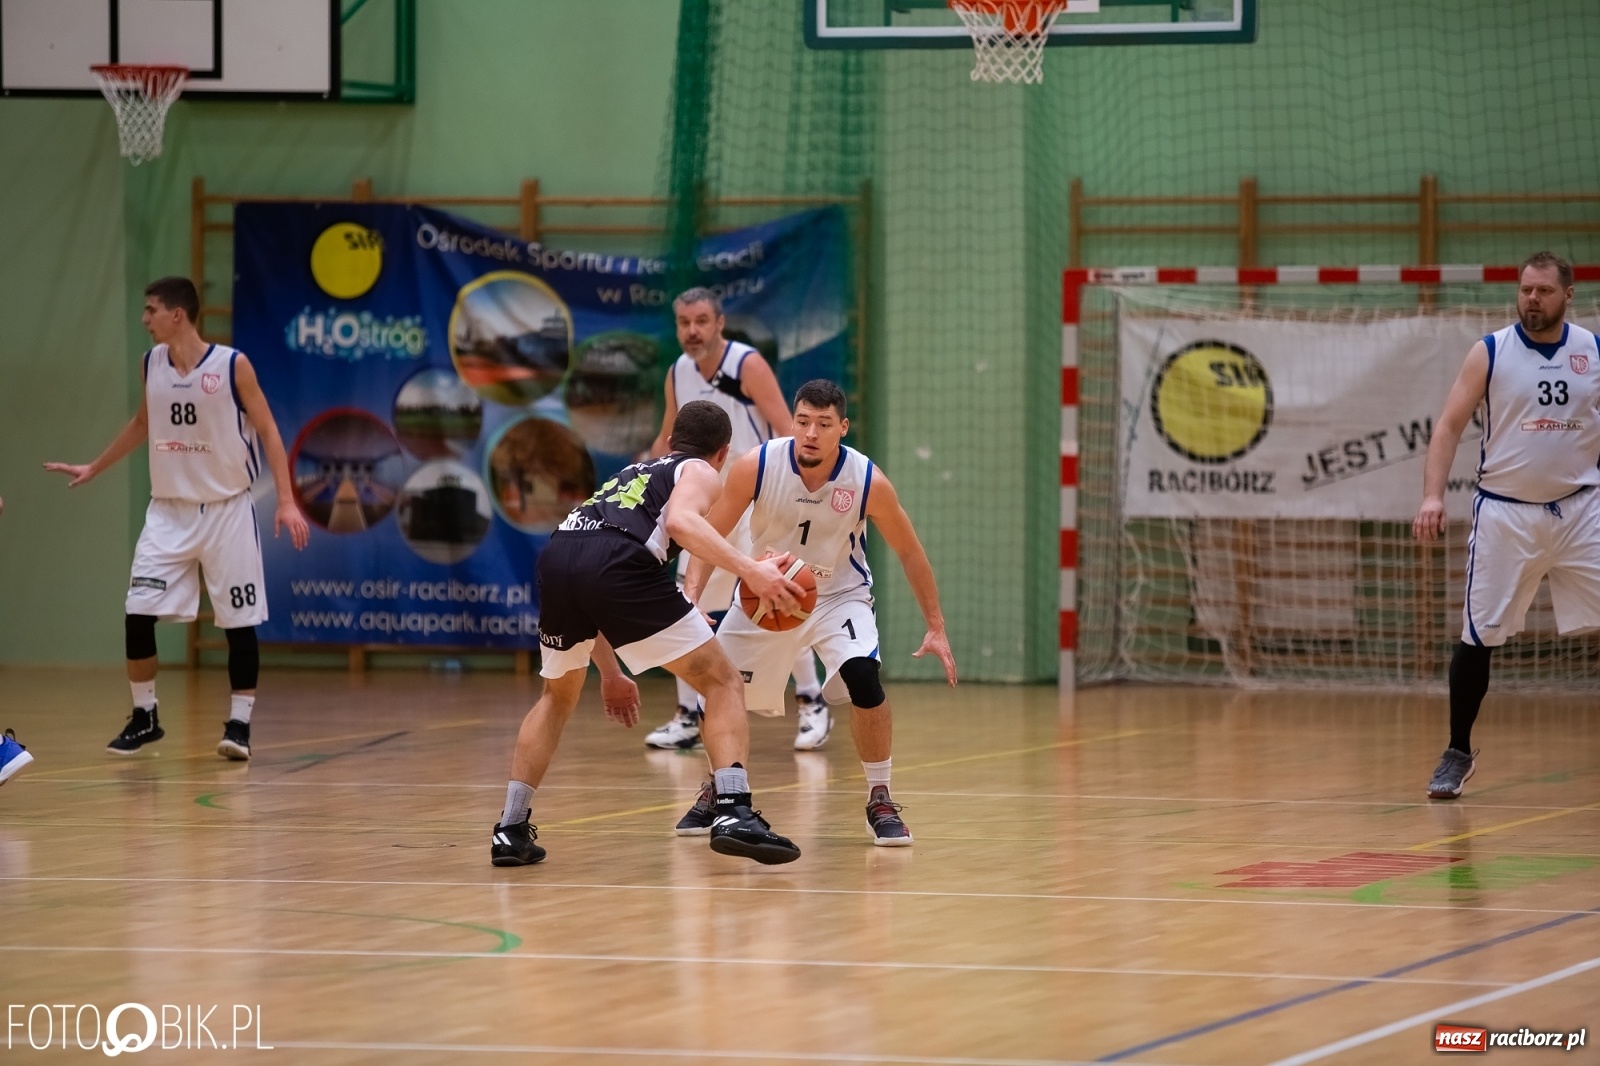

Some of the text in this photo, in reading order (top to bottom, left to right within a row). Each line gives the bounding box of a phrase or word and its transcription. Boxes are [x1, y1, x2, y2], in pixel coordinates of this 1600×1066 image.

[527, 242, 613, 273] Sportu
[1537, 380, 1569, 406] 33
[170, 402, 197, 426] 88
[1302, 430, 1388, 484] JEST
[798, 519, 812, 546] 1
[229, 583, 257, 609] 88
[291, 577, 531, 608] www.osir-raciborz.pl
[841, 618, 857, 640] 1
